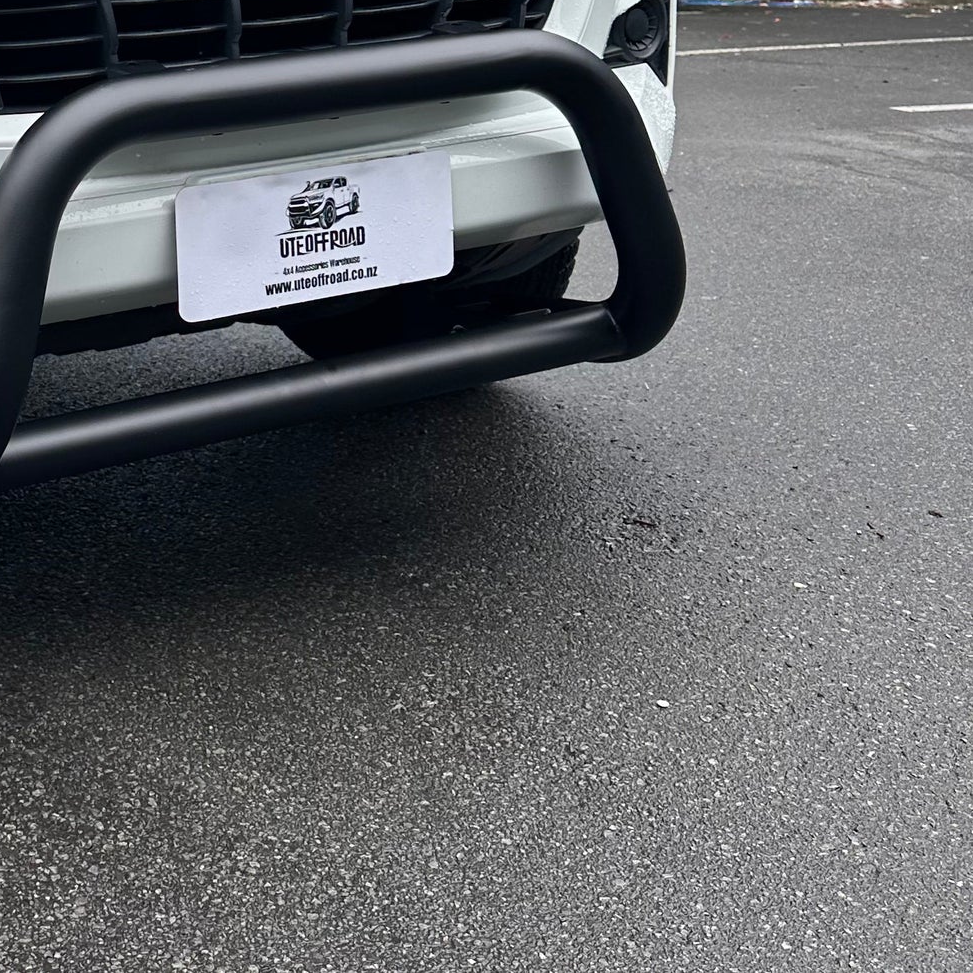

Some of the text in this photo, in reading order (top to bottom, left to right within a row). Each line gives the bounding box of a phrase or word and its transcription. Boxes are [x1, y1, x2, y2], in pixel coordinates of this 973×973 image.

[283, 256, 360, 276] 4x4 Accessories Warehouse
[265, 266, 378, 295] www.uteoffroad.co.nz
